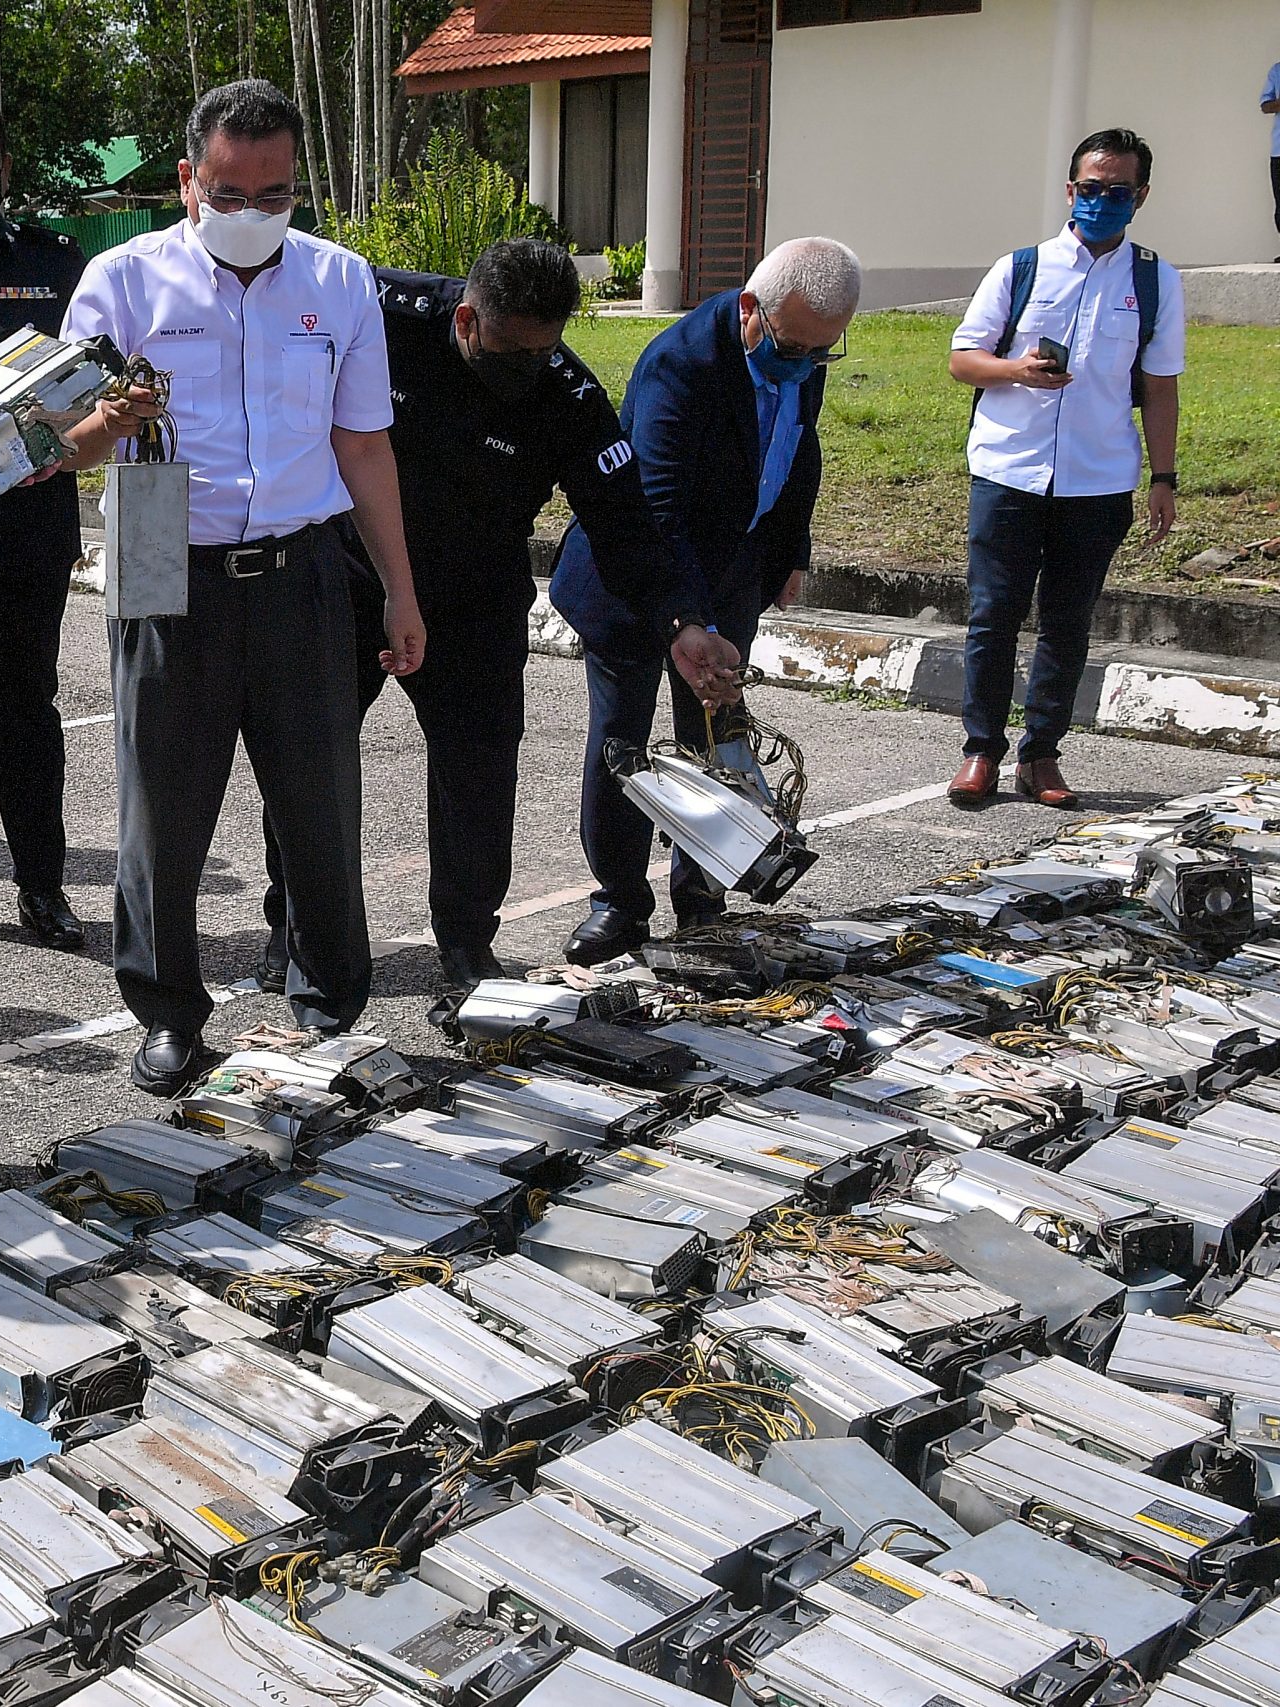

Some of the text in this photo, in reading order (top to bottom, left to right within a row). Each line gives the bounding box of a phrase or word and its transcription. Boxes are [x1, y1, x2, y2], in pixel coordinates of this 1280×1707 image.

[178, 327, 205, 335] NAZMY
[484, 436, 516, 455] POLIS
[597, 439, 632, 474] CID
